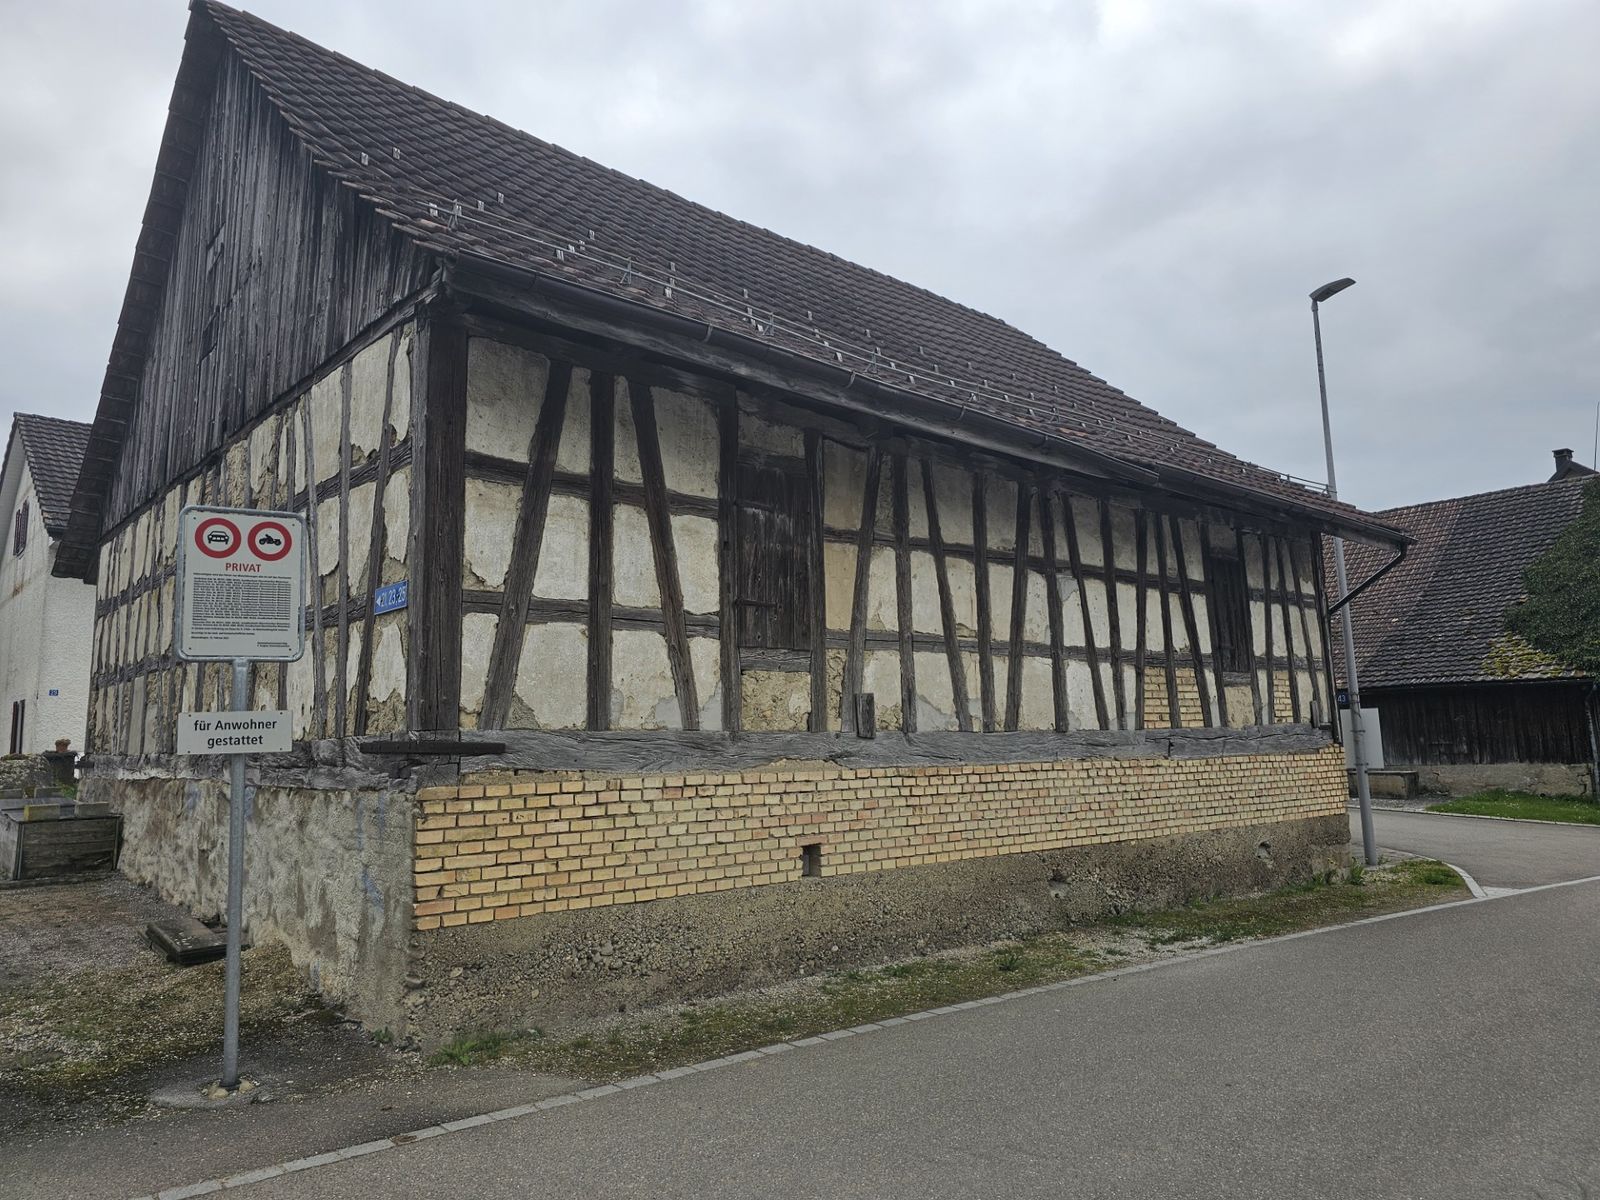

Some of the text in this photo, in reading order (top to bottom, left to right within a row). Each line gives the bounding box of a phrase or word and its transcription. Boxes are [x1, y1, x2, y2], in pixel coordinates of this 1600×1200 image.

[225, 562, 261, 572] PRIVAT
[194, 718, 277, 731] für Anwohner
[207, 735, 263, 749] gestattet
